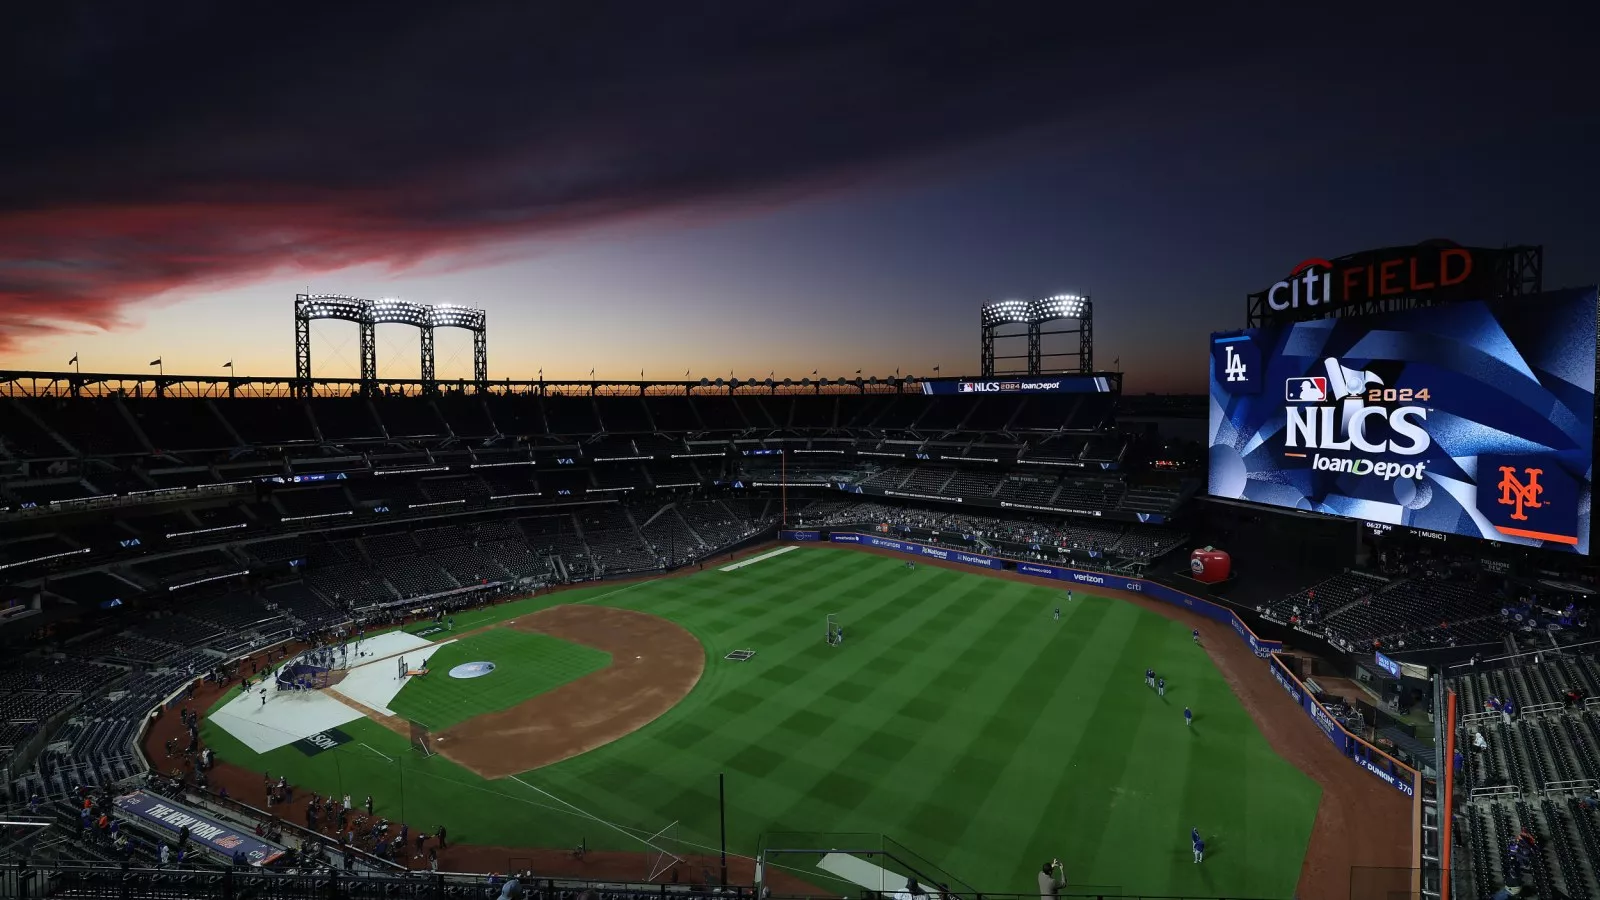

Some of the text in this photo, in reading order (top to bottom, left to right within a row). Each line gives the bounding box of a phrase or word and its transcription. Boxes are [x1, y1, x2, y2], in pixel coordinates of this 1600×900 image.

[1268, 248, 1473, 311] citi FIELD
[1225, 346, 1246, 381] LA
[974, 382, 1000, 392] NLCS
[1021, 381, 1060, 390] loanDepot
[1368, 388, 1430, 402] 2024
[1285, 406, 1430, 455] NLCS
[1313, 453, 1426, 481] loanDepot
[1498, 466, 1543, 520] NY
[962, 554, 991, 566] Northwell
[1073, 573, 1104, 584] verizon
[1126, 583, 1142, 591] citi
[1367, 762, 1413, 796] DUNKIN' 370
[145, 803, 175, 819] THE
[161, 811, 195, 828] NEW
[186, 820, 224, 840] YORK
